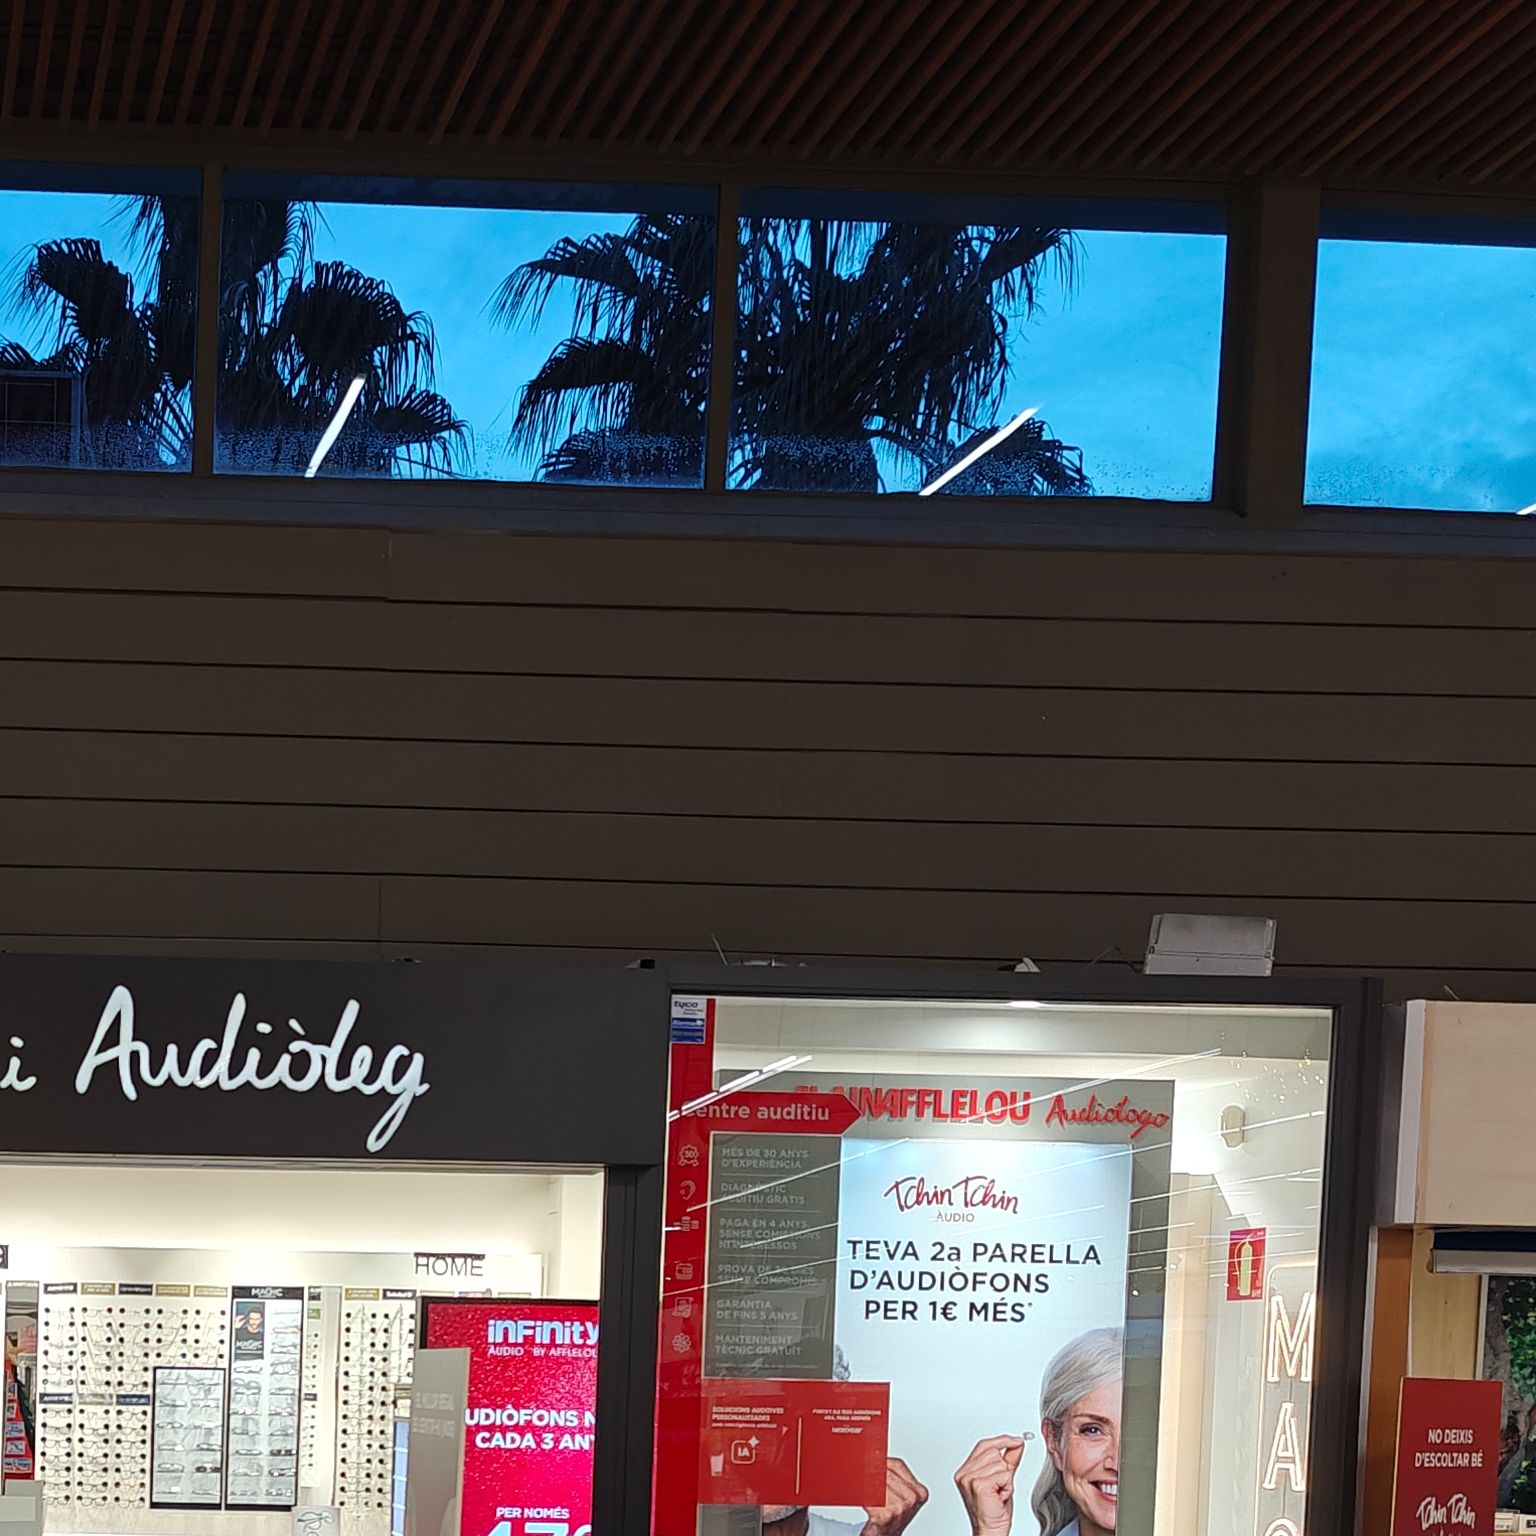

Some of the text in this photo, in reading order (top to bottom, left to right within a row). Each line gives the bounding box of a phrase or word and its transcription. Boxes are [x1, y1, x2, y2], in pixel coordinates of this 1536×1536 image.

[0, 1036, 37, 1091] i
[74, 985, 429, 1153] Audiòleg
[756, 1102, 830, 1121] auditiu
[746, 1149, 762, 1158] DE
[779, 1149, 809, 1159] ANYS
[719, 1218, 749, 1227] PAGA
[846, 1239, 1102, 1266] TEVA 2a PARELLA
[414, 1255, 484, 1277] HOME
[849, 1266, 1050, 1294] D'AUDIÒFONS
[864, 1299, 918, 1321] PER
[928, 1300, 958, 1322] 1€
[465, 1404, 579, 1427] UDIÒFONS
[475, 1432, 595, 1451] CADA 3 AN
[1428, 1428, 1474, 1445] NO DEIXIS
[1414, 1449, 1483, 1468] D'ESCOLTAR BÉ
[495, 1505, 570, 1519] PER NOMÉS
